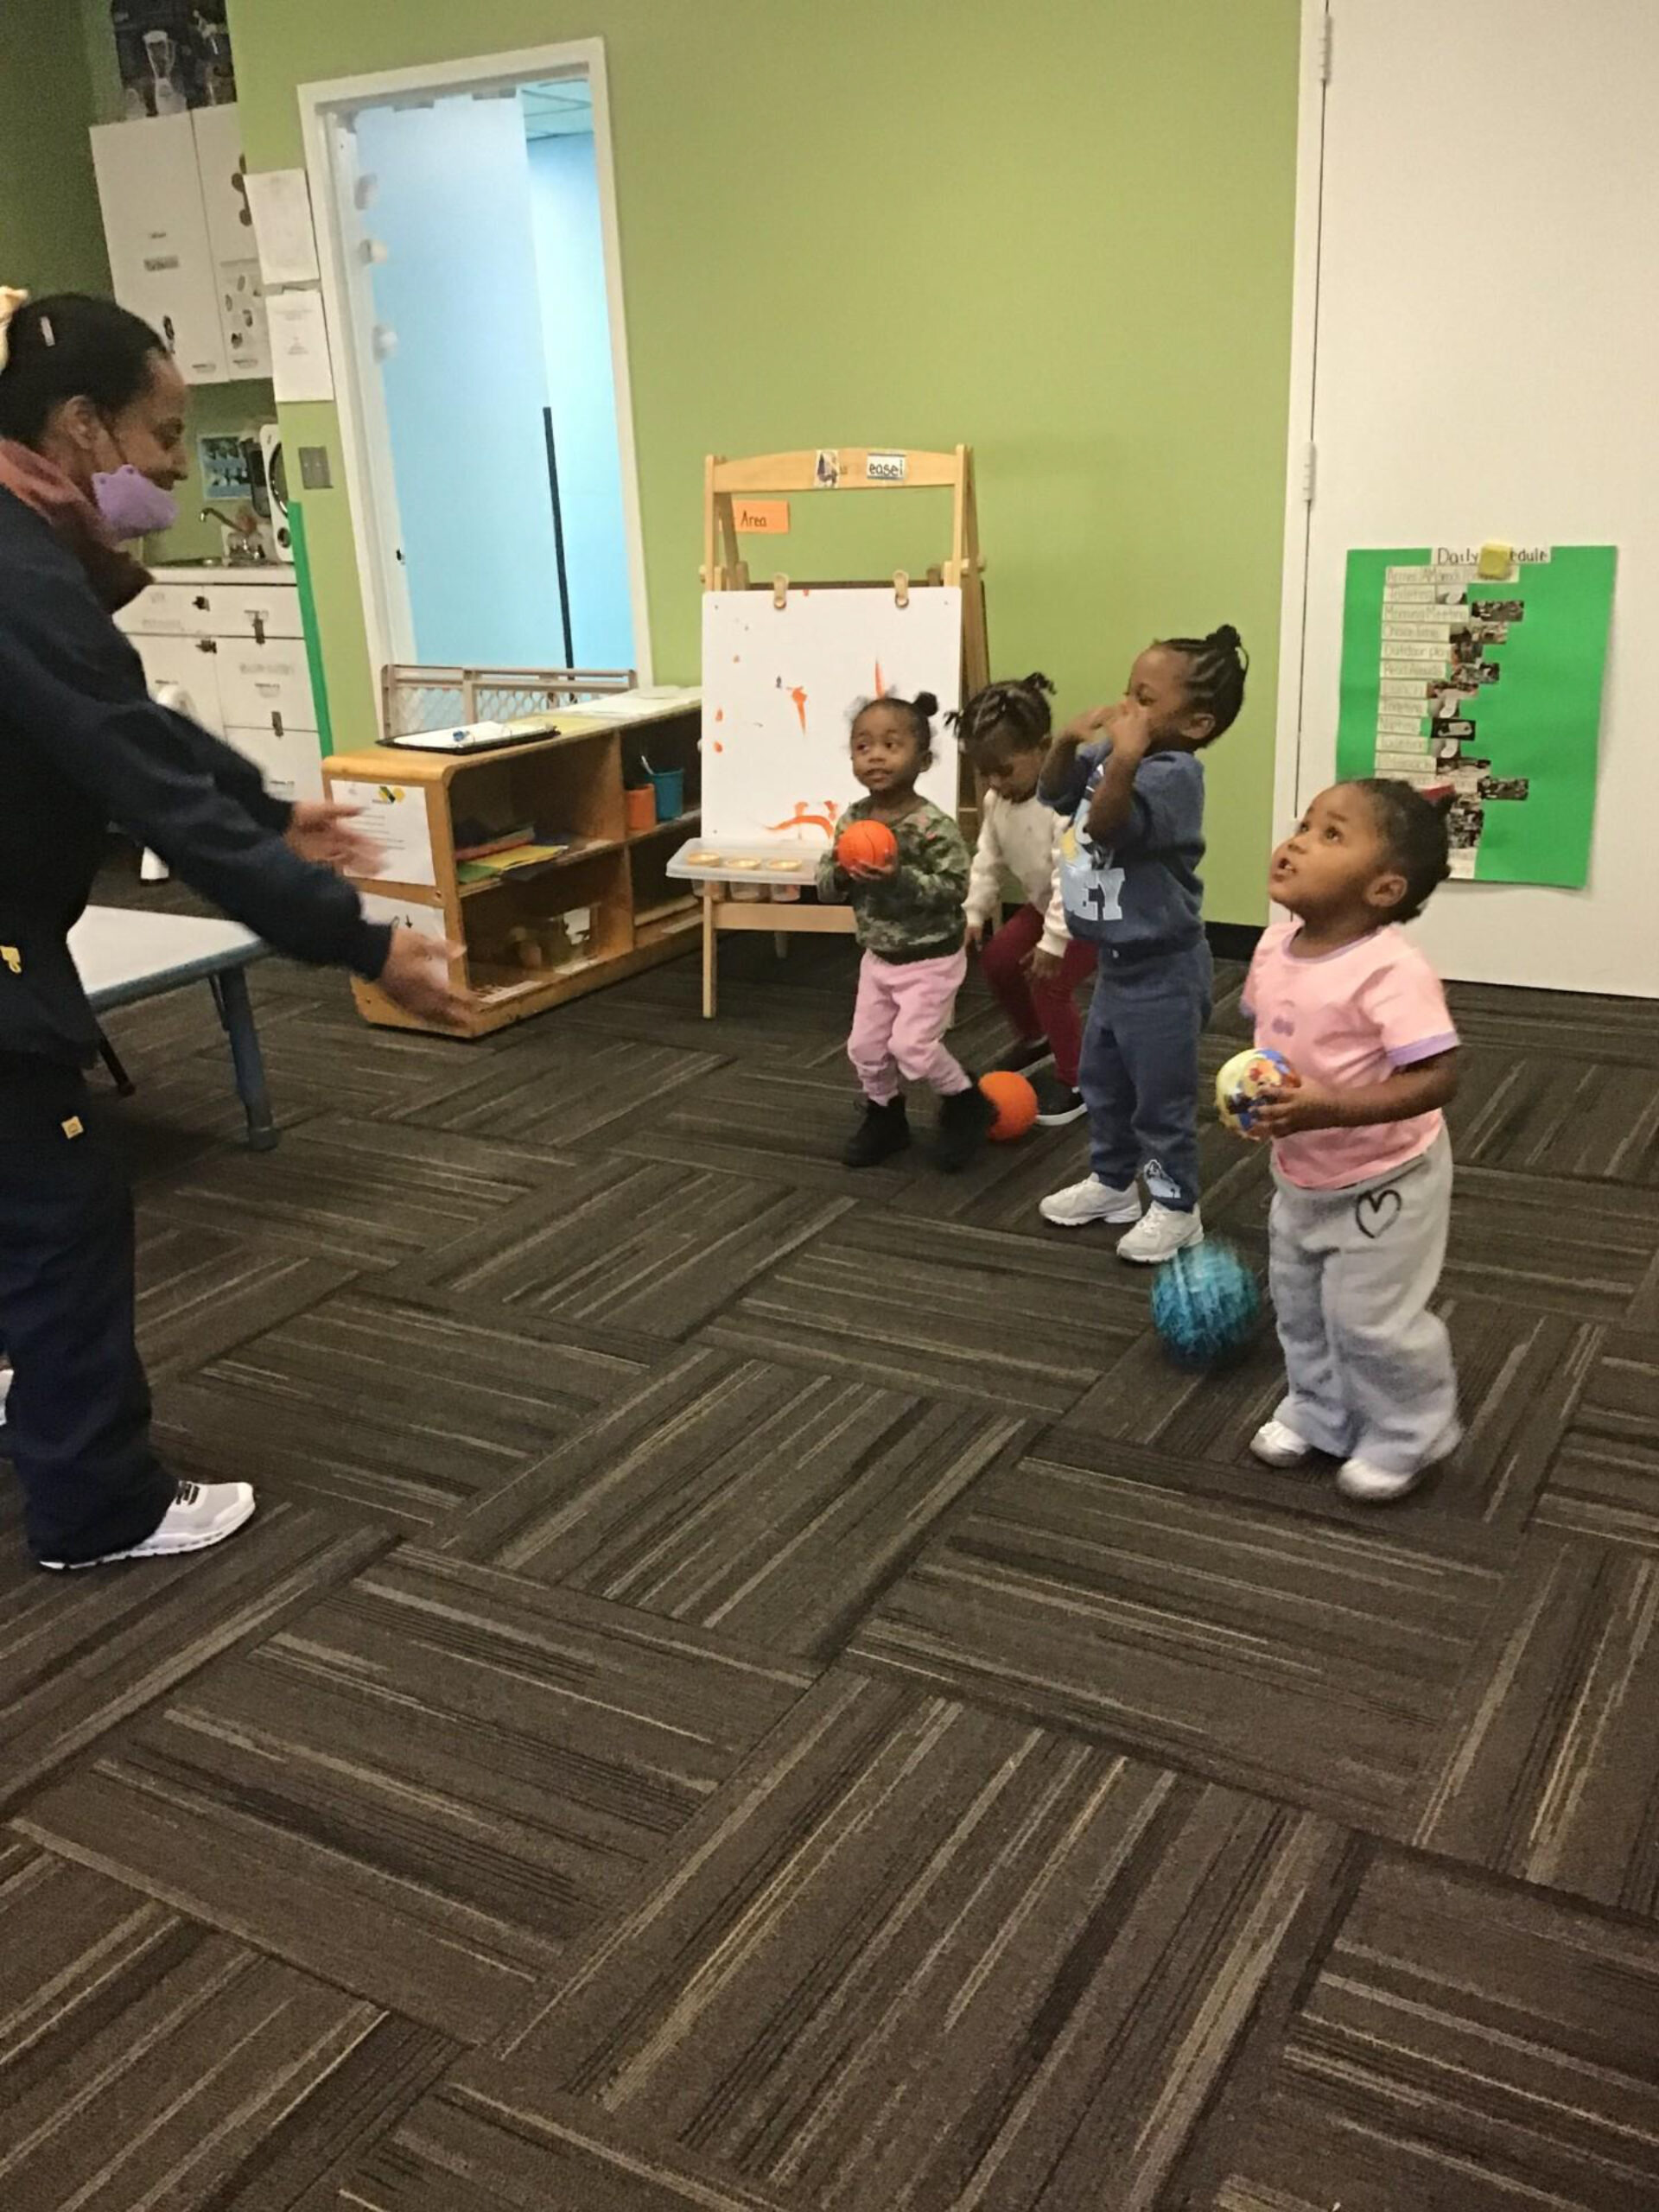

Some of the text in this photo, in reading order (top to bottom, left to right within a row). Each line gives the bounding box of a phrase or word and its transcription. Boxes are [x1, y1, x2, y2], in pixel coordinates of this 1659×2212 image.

[868, 459, 903, 476] easel
[741, 510, 766, 527] Area
[1437, 546, 1478, 565] Daily
